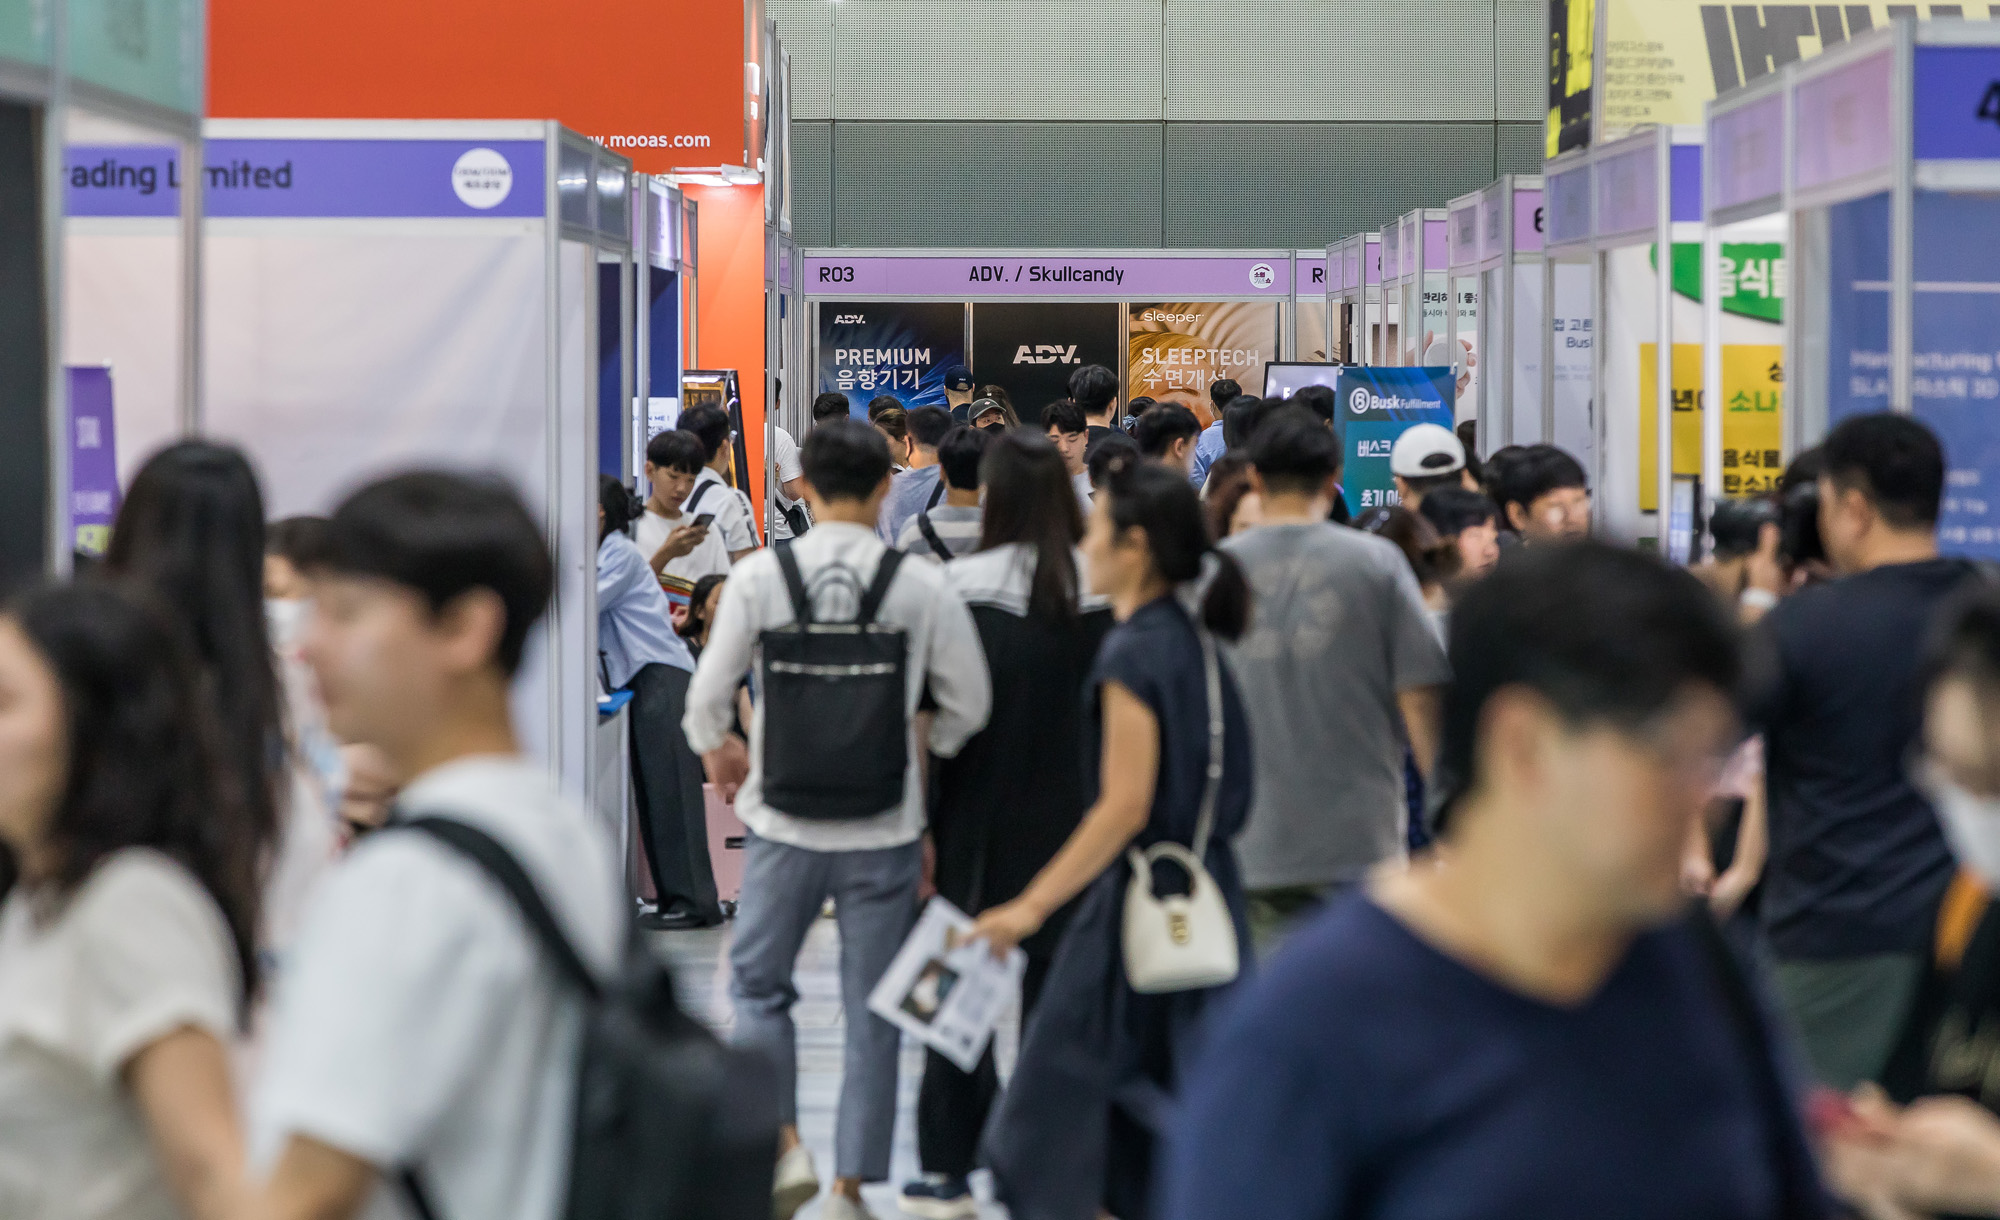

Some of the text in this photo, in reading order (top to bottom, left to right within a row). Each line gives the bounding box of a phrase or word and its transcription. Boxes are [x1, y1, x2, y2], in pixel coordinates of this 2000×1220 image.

[63, 159, 293, 195] ading Lmited
[968, 265, 1125, 286] ADV. / Skullcandy
[1312, 267, 1327, 284] R
[834, 314, 866, 325] ADV.
[1143, 310, 1202, 325] sleeper
[835, 347, 931, 366] PREMIUM
[1012, 344, 1081, 365] ADV.
[1142, 347, 1259, 367] SLEEPTECH
[835, 368, 920, 391] 음향기기
[1370, 394, 1400, 409] Busk
